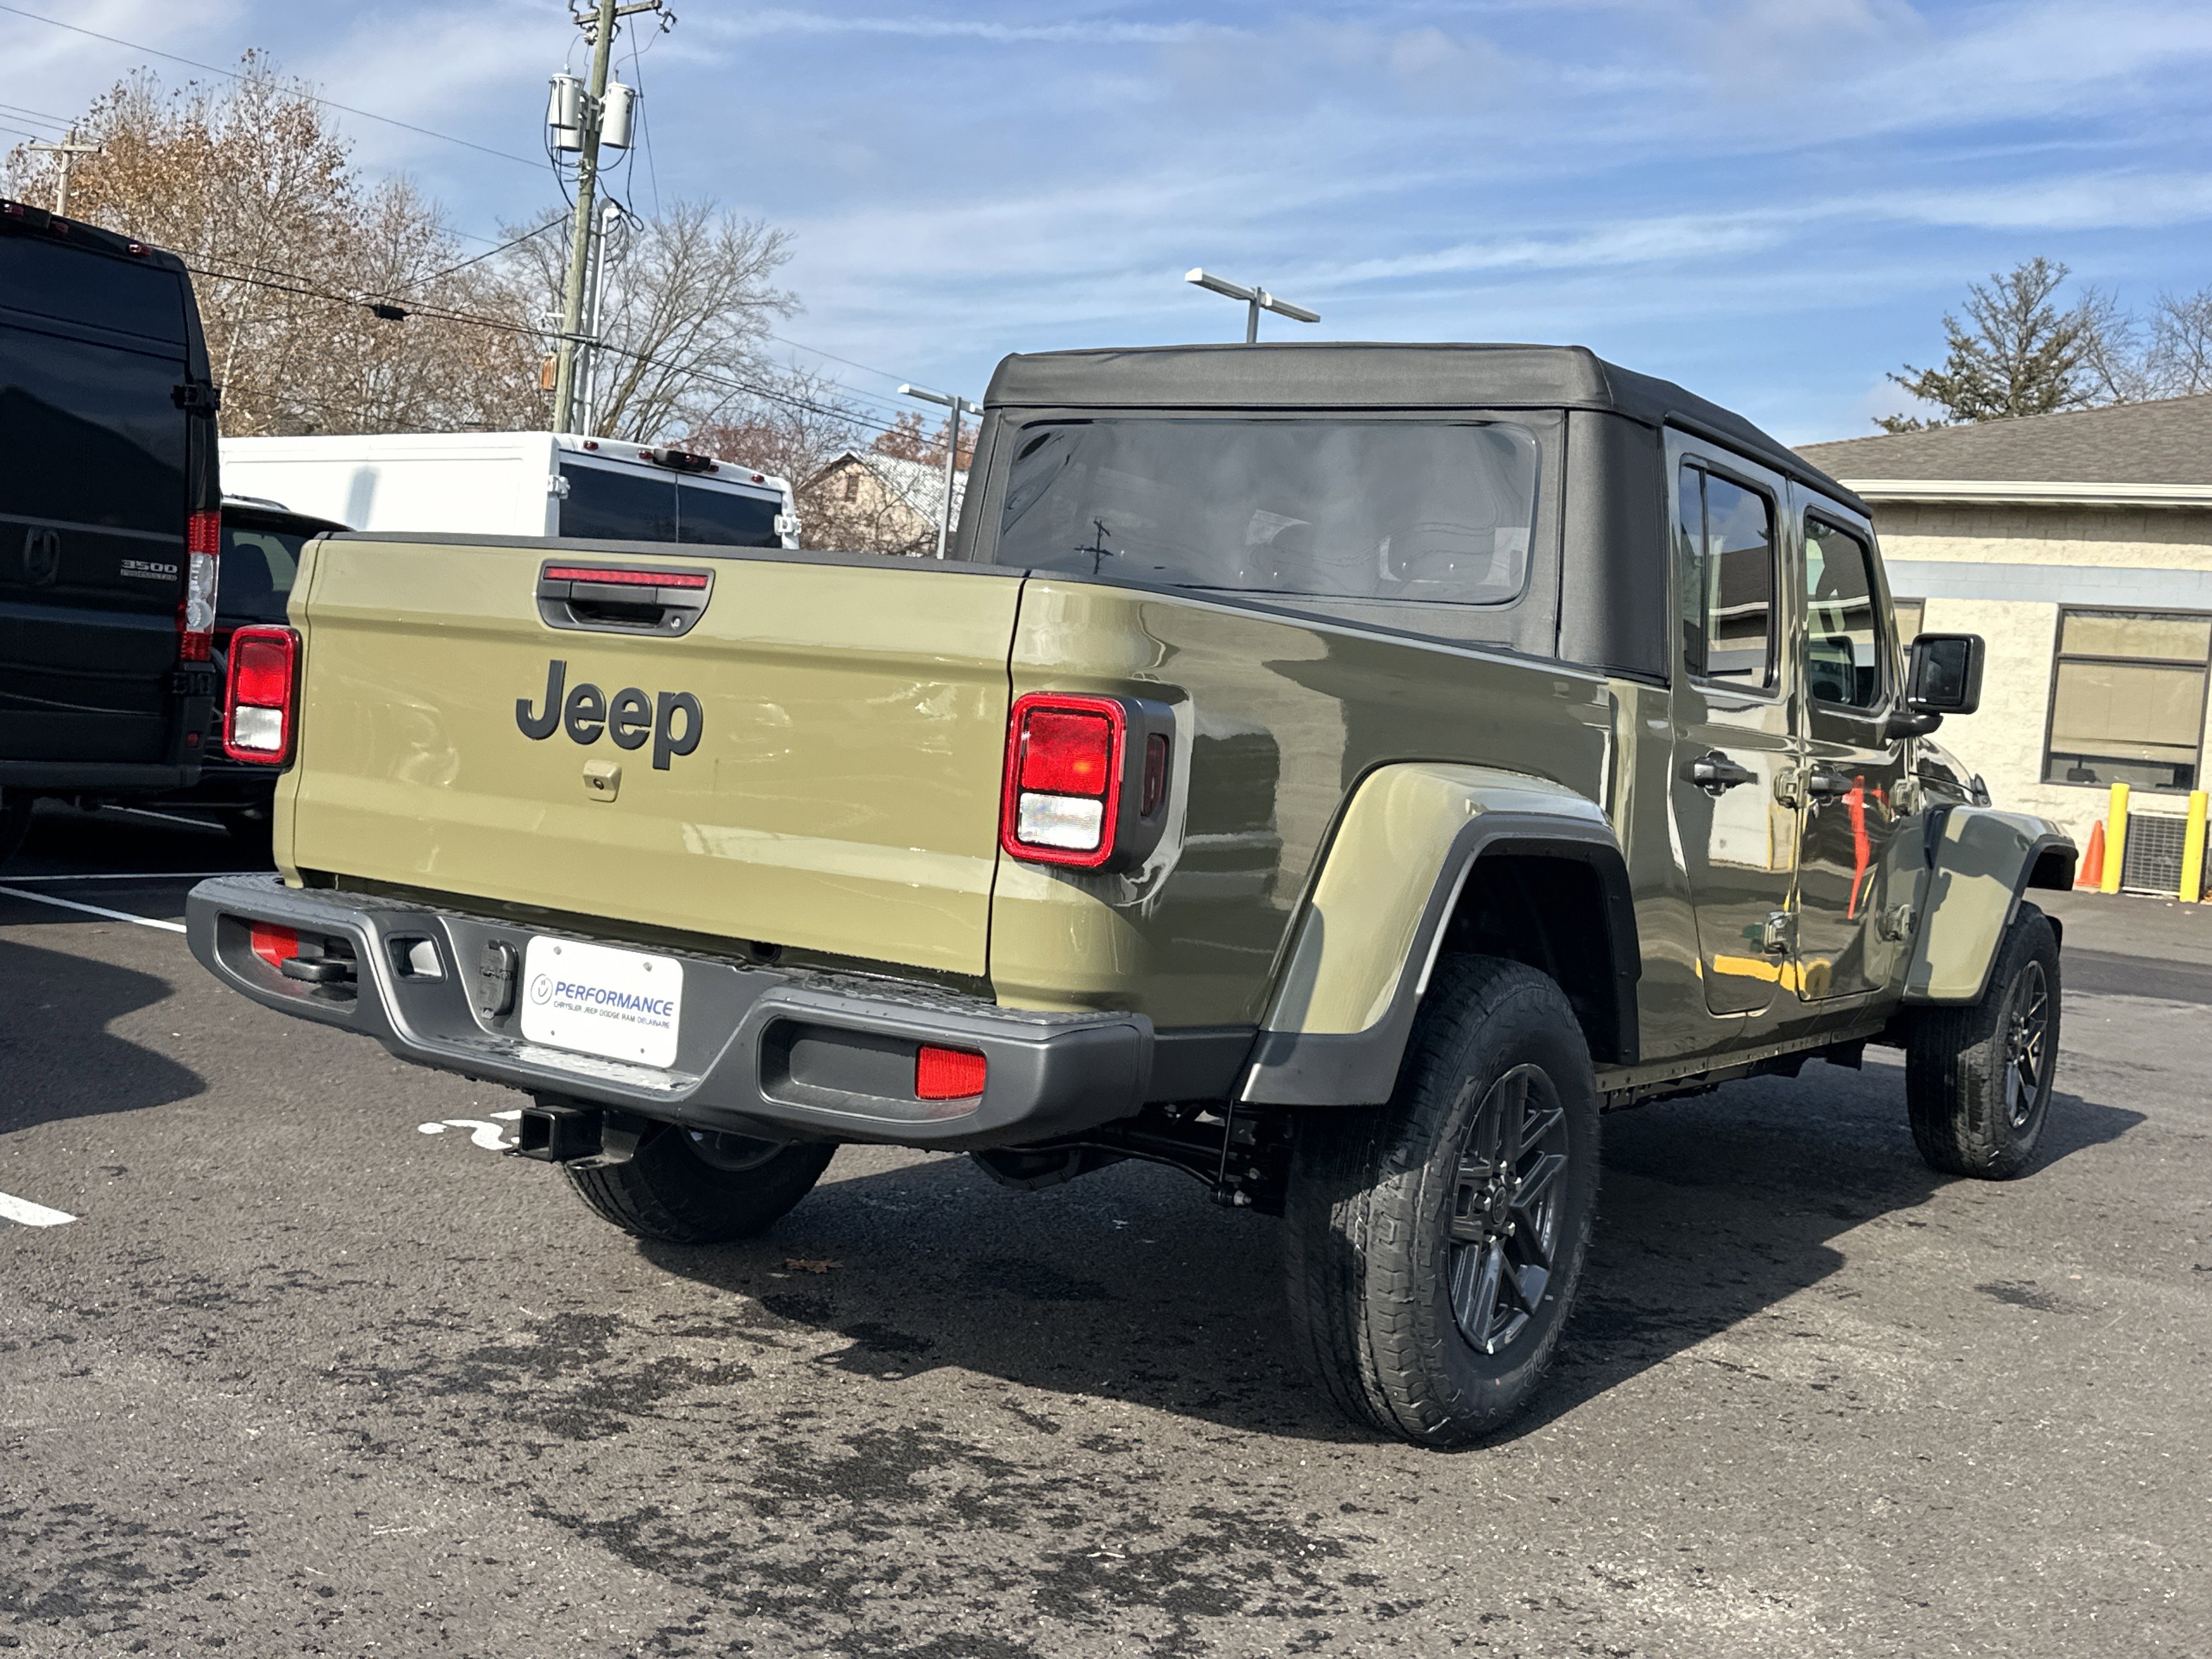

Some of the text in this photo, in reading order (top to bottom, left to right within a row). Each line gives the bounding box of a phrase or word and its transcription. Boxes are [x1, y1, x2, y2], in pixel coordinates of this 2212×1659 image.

[121, 559, 177, 573] 3500
[516, 659, 703, 771] Jeep
[555, 981, 674, 1016] PERFORMANCE
[600, 1009, 620, 1019] DODGE
[622, 1013, 636, 1023] RAM
